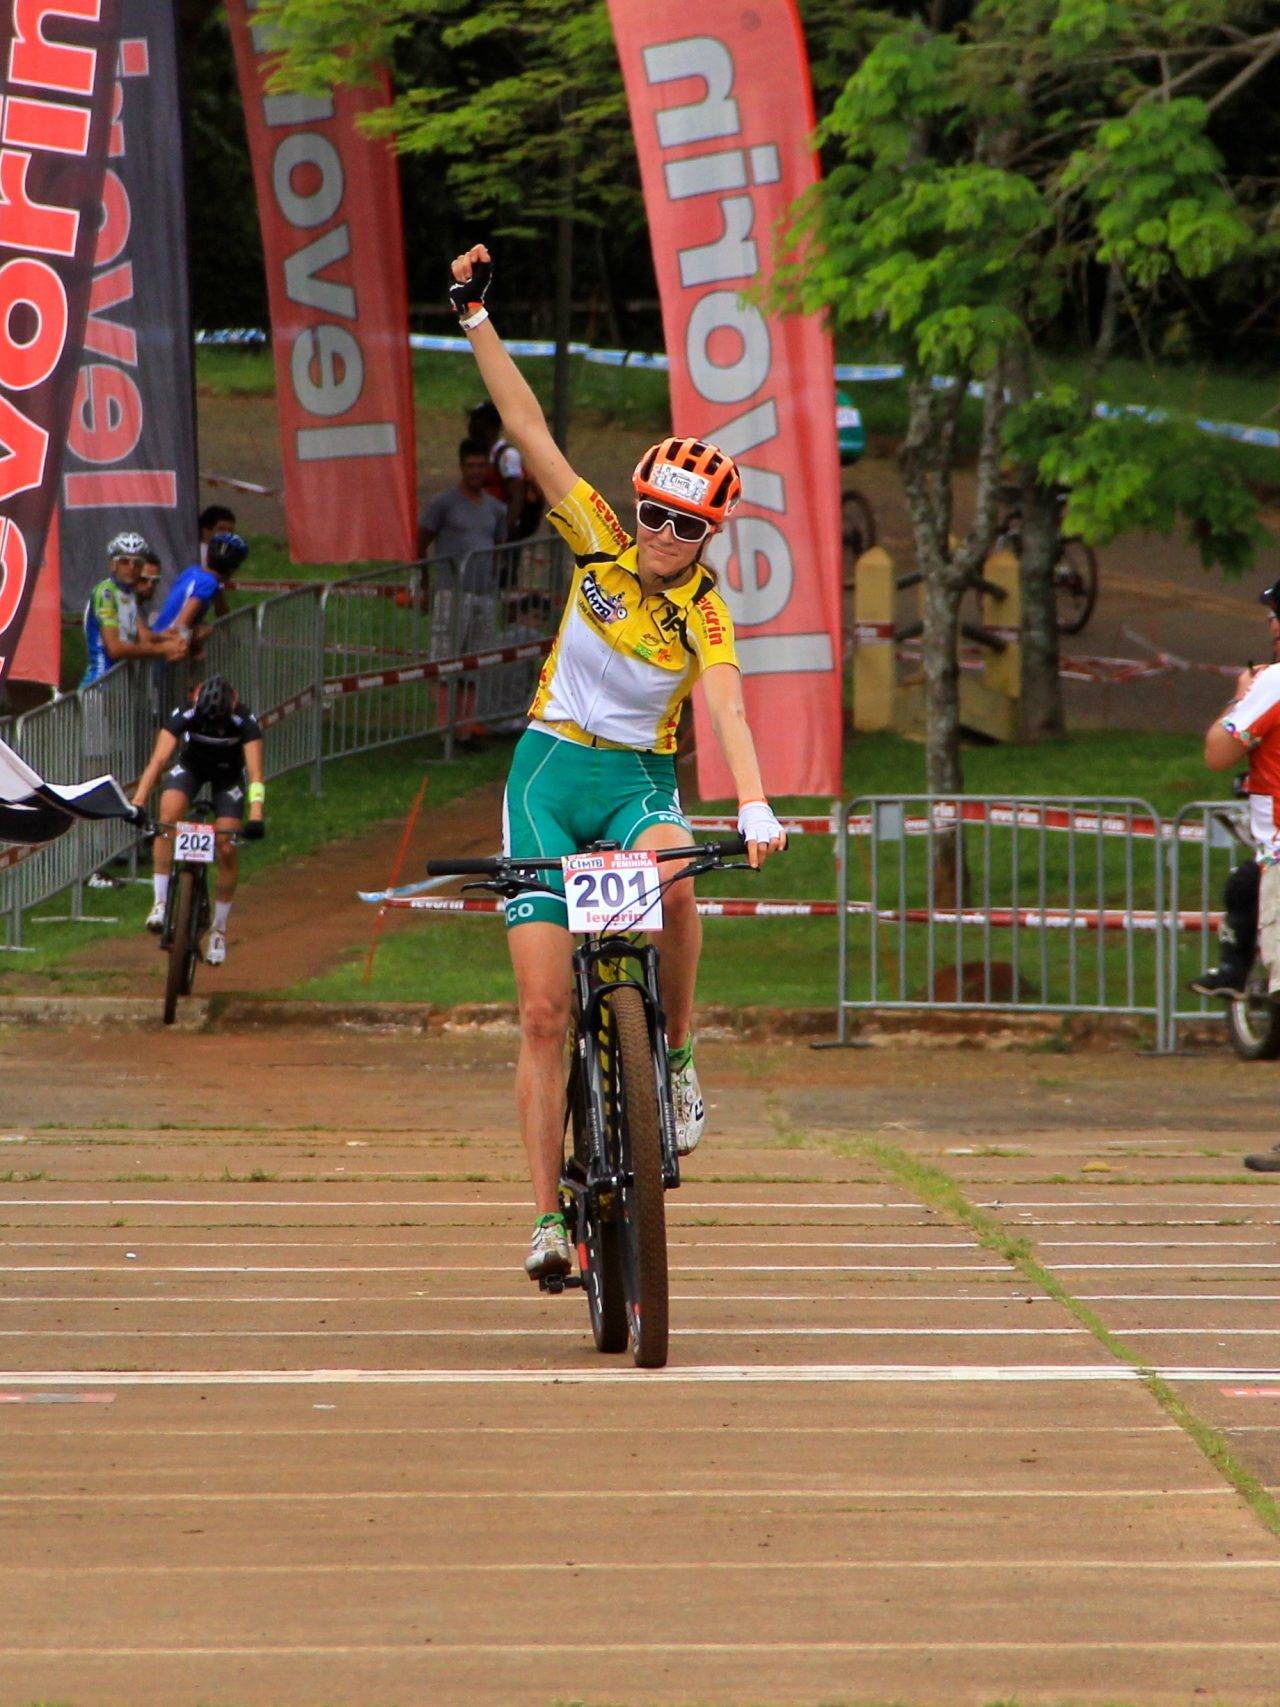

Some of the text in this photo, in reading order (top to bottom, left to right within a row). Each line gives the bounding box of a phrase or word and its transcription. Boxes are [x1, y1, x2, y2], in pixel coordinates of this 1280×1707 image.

[180, 833, 211, 851] 202
[613, 852, 648, 860] ELITE
[569, 858, 603, 870] CIMTB
[610, 859, 653, 868] FEMININA
[573, 870, 648, 908] 201
[586, 910, 644, 923] levorin
